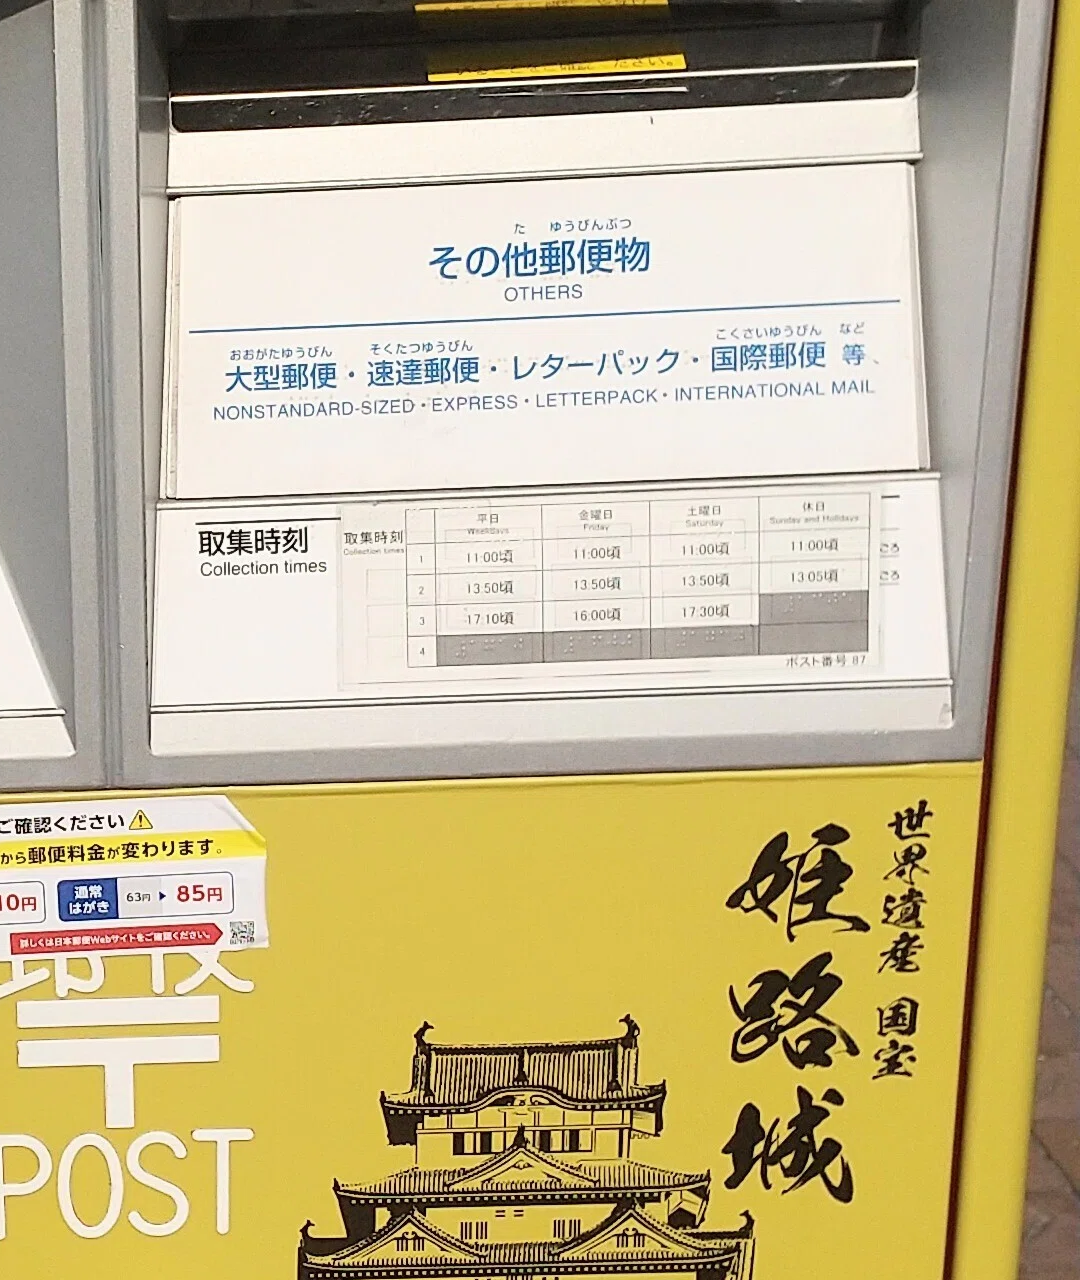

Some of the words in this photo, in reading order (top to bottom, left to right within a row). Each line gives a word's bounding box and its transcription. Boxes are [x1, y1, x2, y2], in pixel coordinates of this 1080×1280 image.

[550, 218, 632, 233] ゆうびんぶつ
[429, 237, 651, 280] その他郵便物
[504, 283, 583, 302] OTHERS
[229, 346, 333, 362] おおがたゆうびん
[370, 339, 474, 356] そくたつゆうびん
[716, 324, 822, 340] こくさいゆうびん
[213, 398, 416, 421] NONSTANDARD-SIZED
[431, 394, 519, 413] EXPRESS
[535, 388, 658, 409] LETTERPACK
[674, 381, 826, 403] INTERNATIONAL
[831, 379, 876, 396] MAIL
[687, 505, 722, 517] 土曜日
[803, 501, 825, 512] 休日
[477, 513, 500, 525] 平日
[578, 508, 614, 521] 金曜日
[770, 516, 801, 525] Sunday
[804, 515, 820, 524] and
[822, 514, 859, 523] Holidays
[583, 523, 610, 532] Friday
[685, 519, 724, 528] Saturday
[197, 526, 309, 558] 取集時刻
[343, 530, 404, 545] 取集時刻
[343, 548, 382, 556] Collection
[200, 561, 279, 577] Collection
[284, 559, 328, 574] times
[418, 586, 425, 595] 2
[419, 616, 425, 626] 3
[419, 647, 425, 656] 4
[786, 655, 847, 668] ポスト番号
[73, 885, 103, 899] 通常
[876, 799, 934, 974] 世界遺産
[126, 892, 151, 902] 63円
[176, 885, 223, 903] 85円
[69, 900, 110, 915] はがき
[721, 822, 871, 1204] 姫路城
[871, 995, 920, 1081] 国宝
